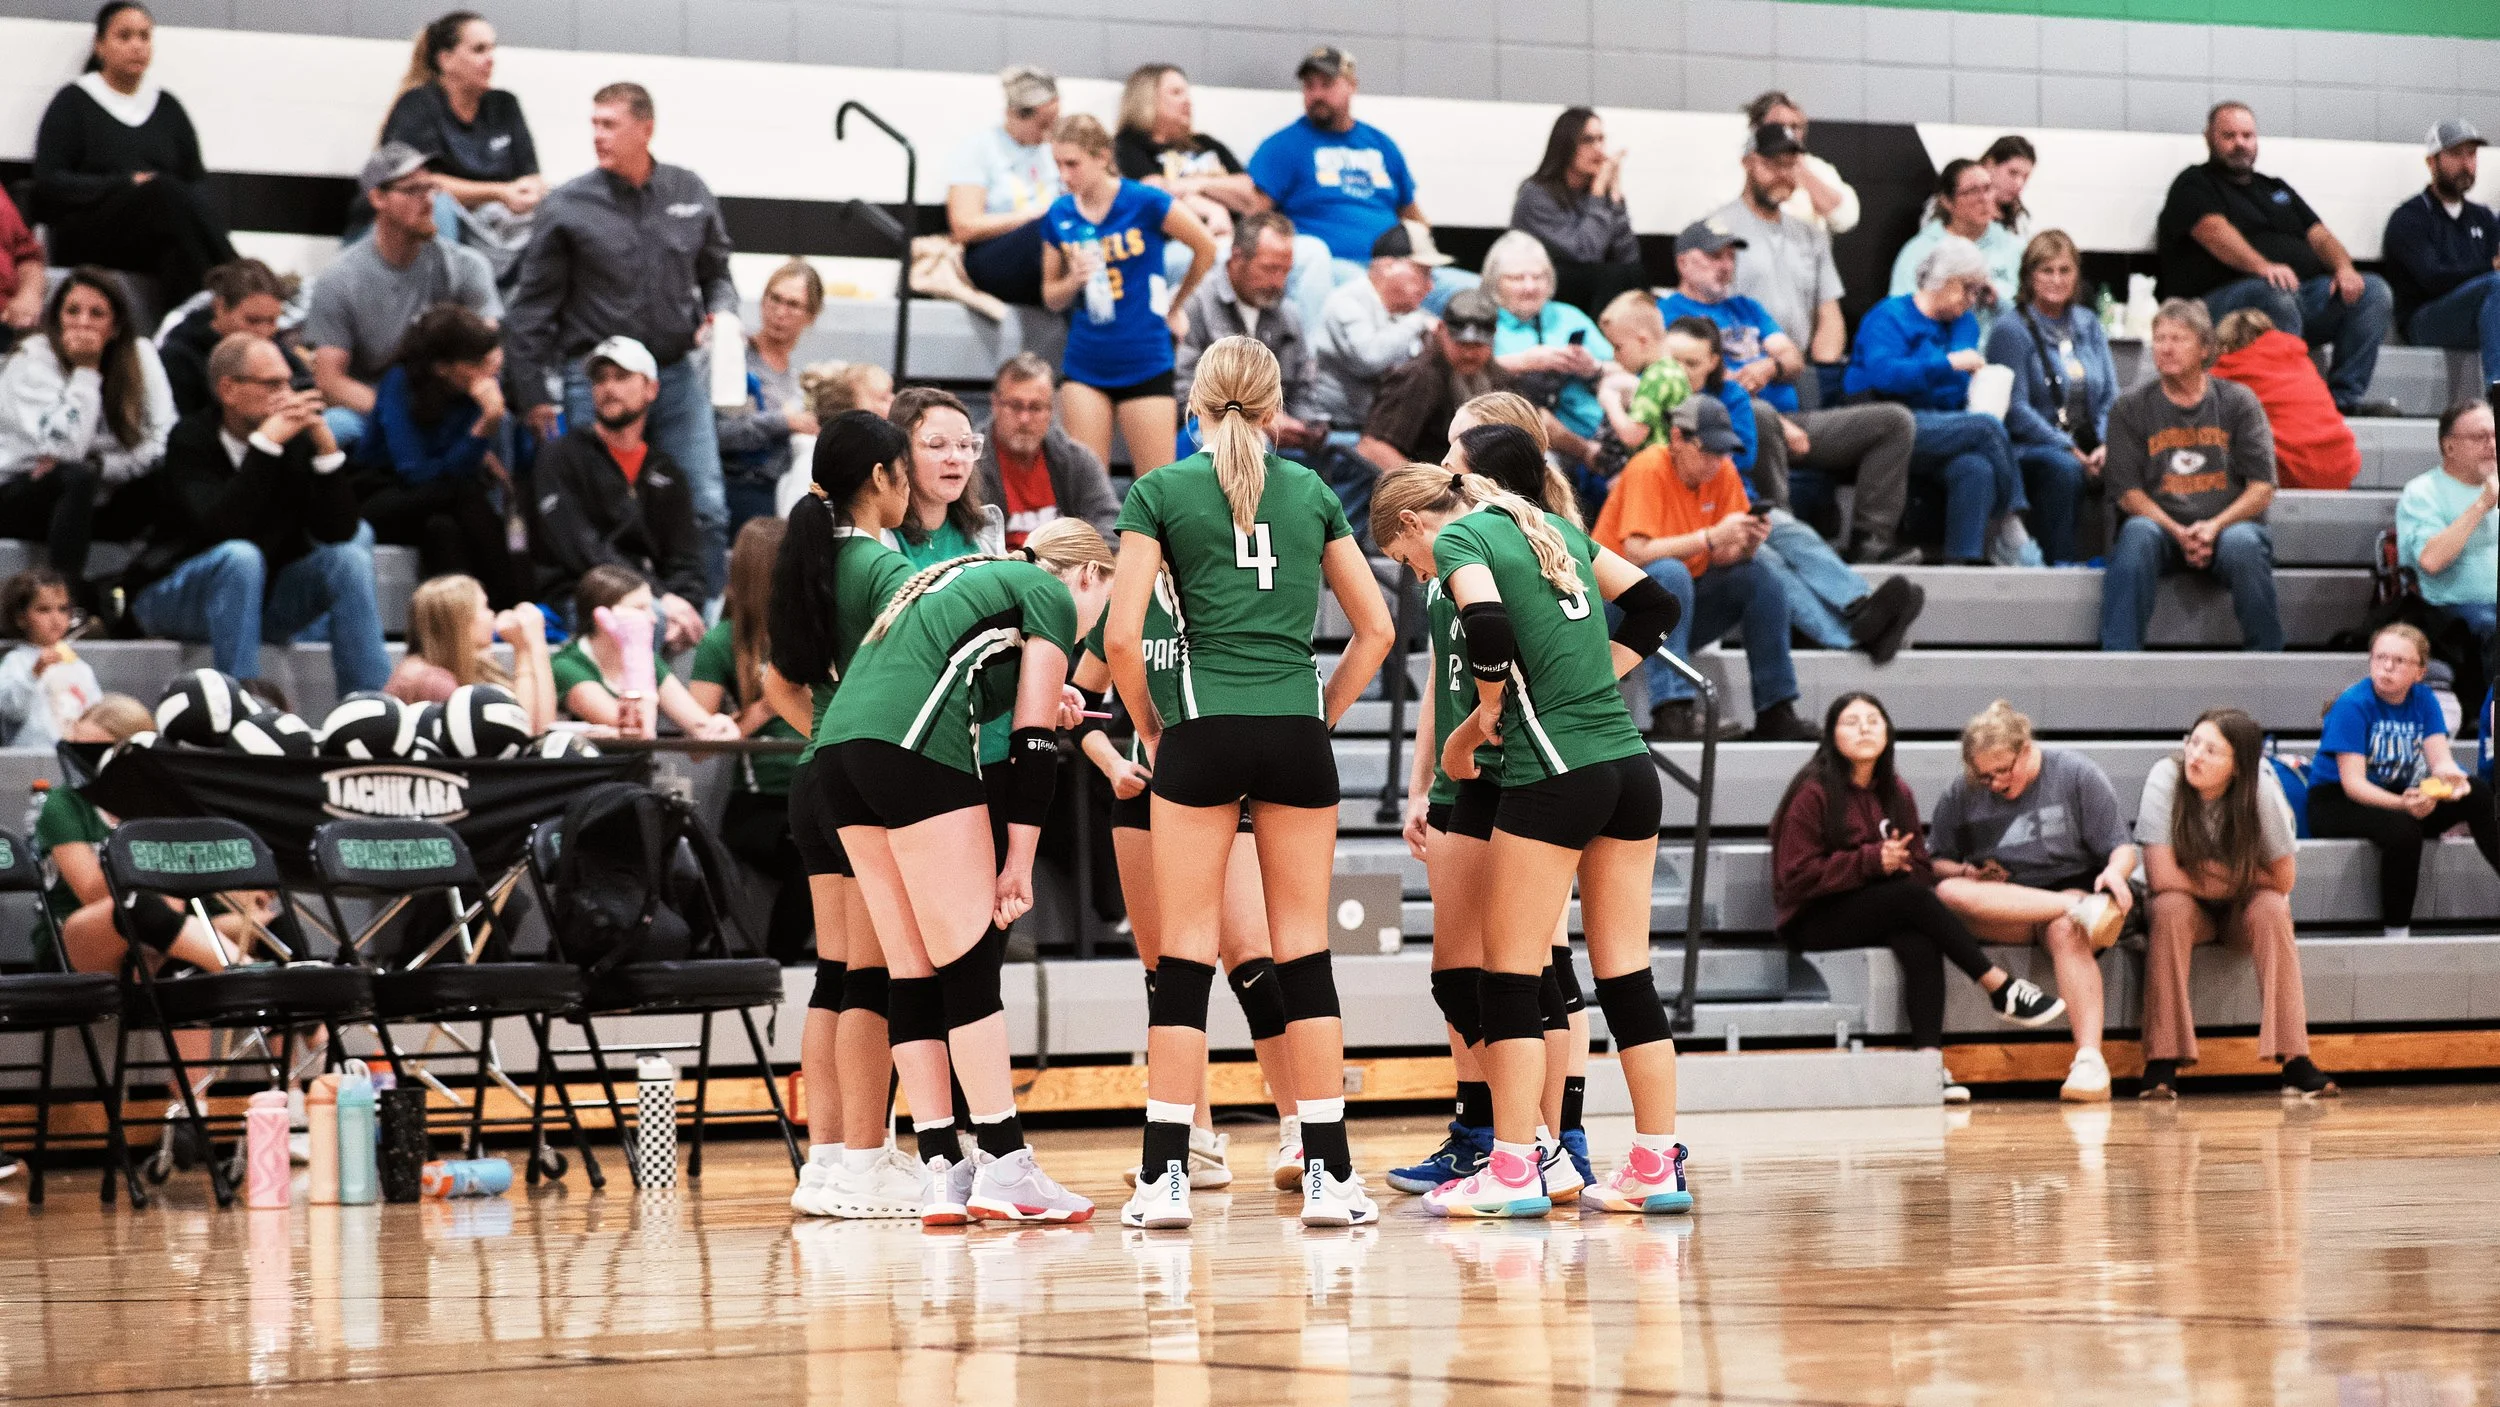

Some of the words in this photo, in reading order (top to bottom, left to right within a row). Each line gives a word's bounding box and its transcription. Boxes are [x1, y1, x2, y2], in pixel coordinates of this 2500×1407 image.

[1231, 521, 1279, 591] 4
[324, 773, 464, 817] TACHIKARA
[128, 838, 256, 873] SPARTANS
[337, 837, 457, 871] SPARTANS
